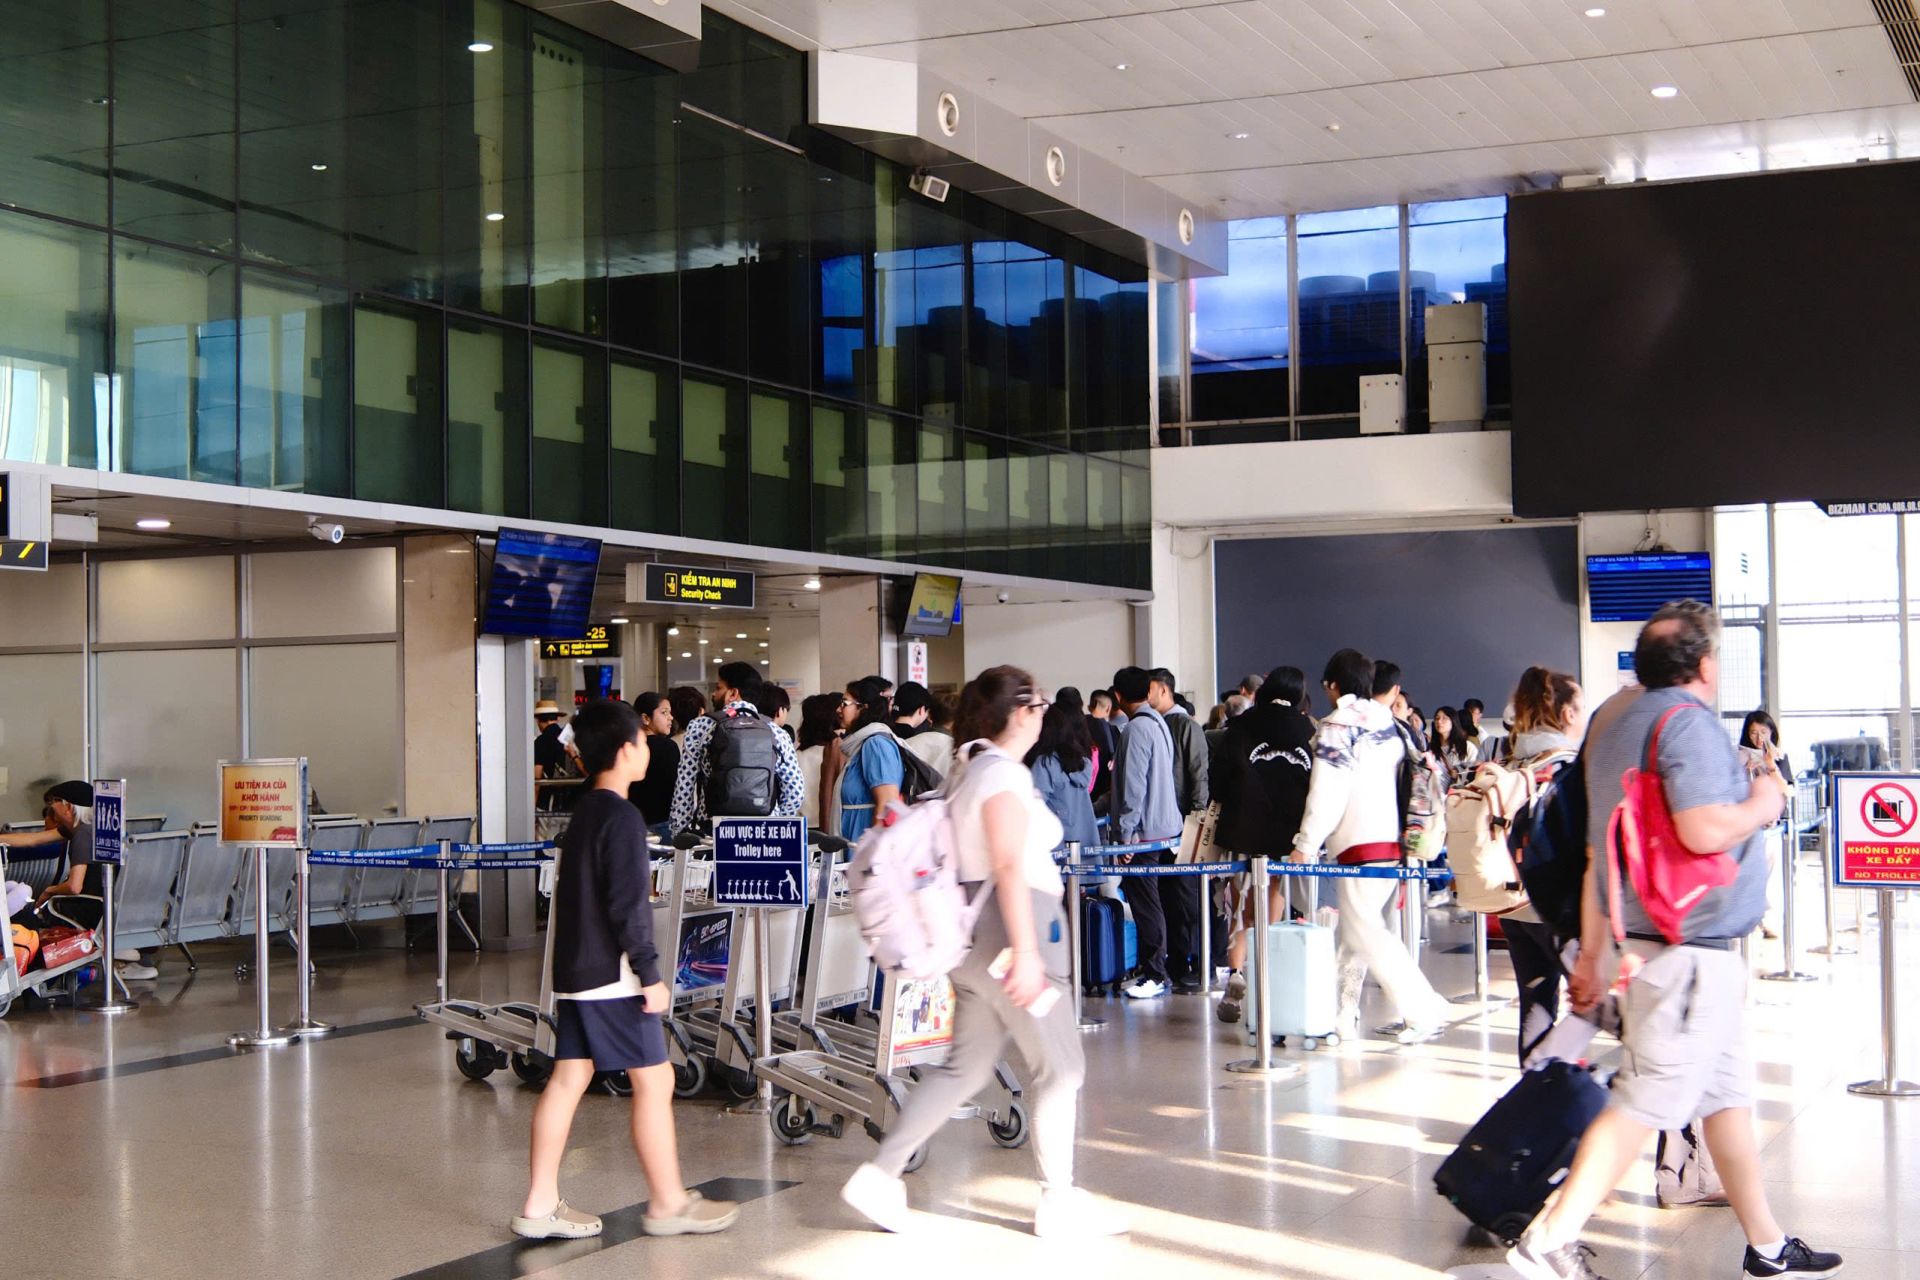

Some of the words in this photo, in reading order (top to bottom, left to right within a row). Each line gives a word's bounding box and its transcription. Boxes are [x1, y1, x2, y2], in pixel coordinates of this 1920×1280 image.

[1828, 503, 1866, 515] BIZMAN
[681, 570, 697, 585] KIỂM
[698, 576, 711, 586] TRA
[711, 578, 720, 587] AN
[722, 578, 736, 588] NINH
[681, 588, 704, 600] Security
[704, 589, 721, 600] Check
[246, 779, 260, 789] TIÊN
[262, 781, 271, 789] RA
[720, 826, 736, 839] KHU
[737, 825, 753, 842] VỰC
[755, 821, 766, 839] ĐỂ
[768, 826, 778, 839] XE
[780, 822, 796, 839] ĐẨY
[459, 844, 471, 852] TIA
[1161, 840, 1169, 848] TIA
[734, 844, 761, 858] Trolley
[763, 844, 782, 857] here
[1848, 846, 1889, 854] KHÔNG
[1894, 846, 1920, 854] DÙN
[436, 860, 455, 868] TIA
[1149, 865, 1200, 873] INTERNATIONAL
[1395, 868, 1421, 877] TIA
